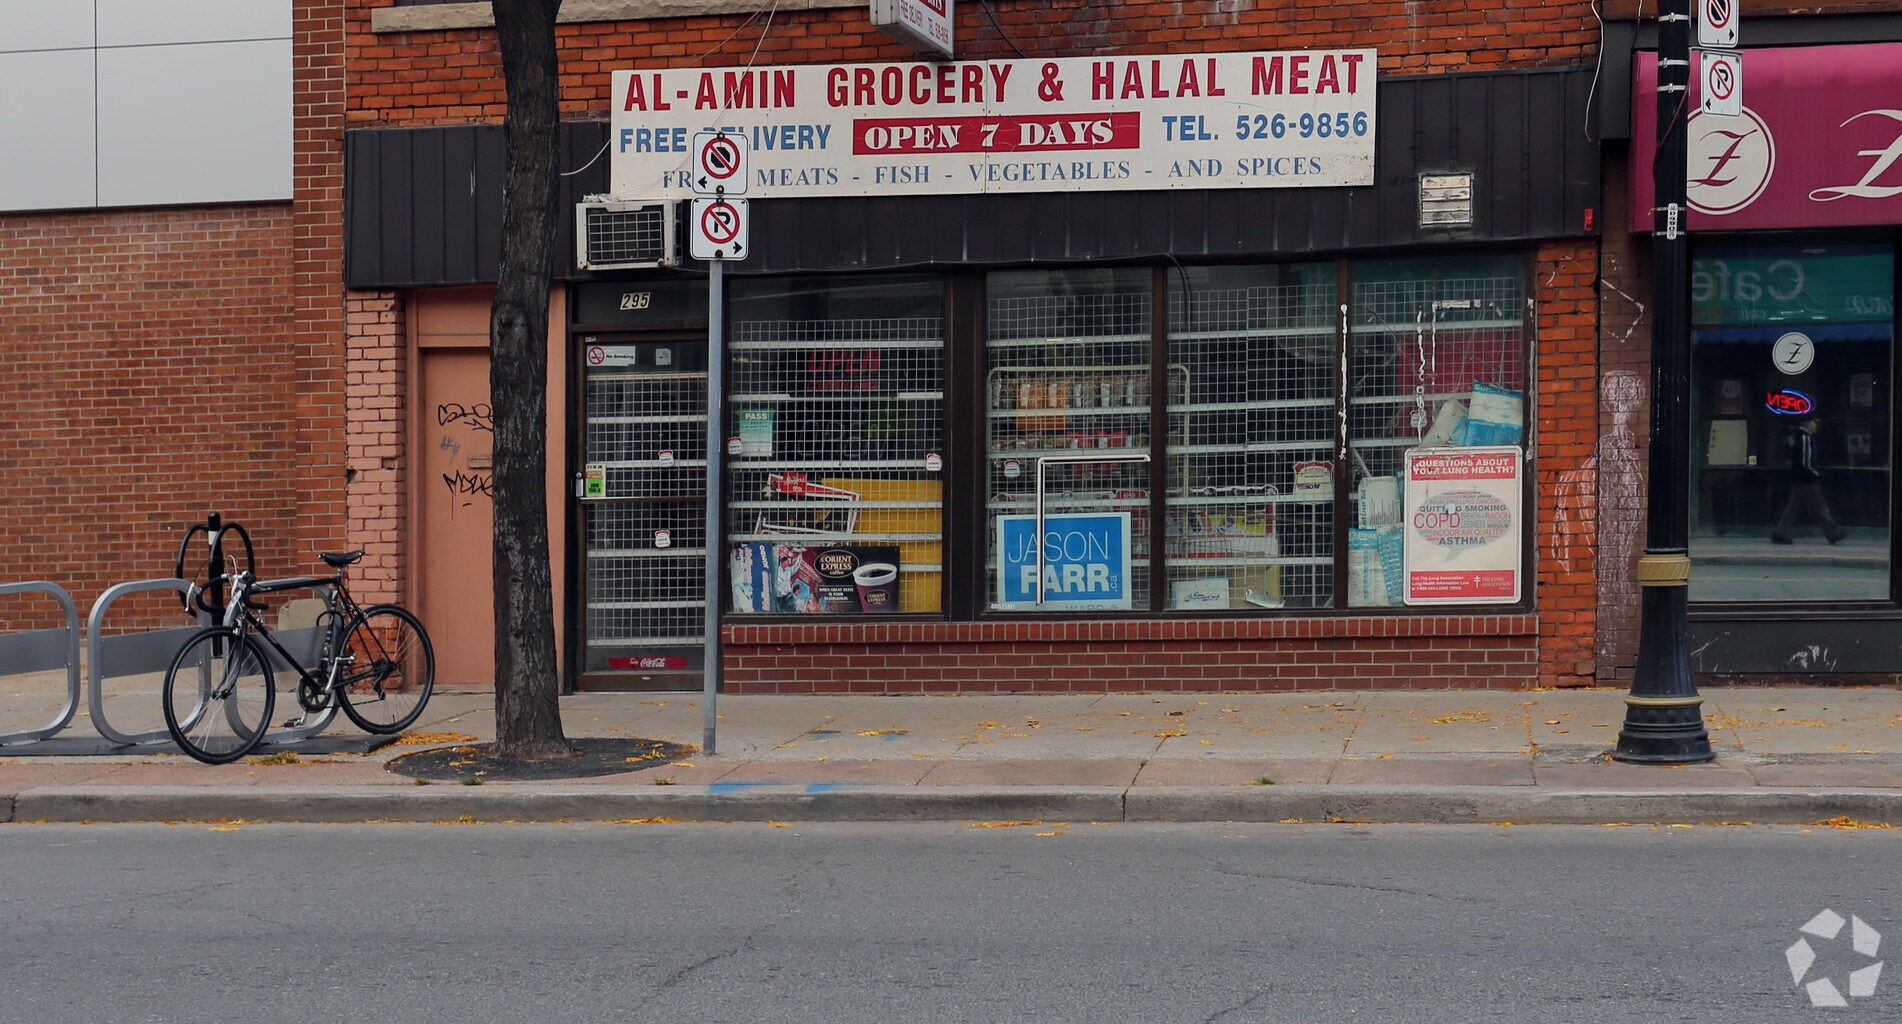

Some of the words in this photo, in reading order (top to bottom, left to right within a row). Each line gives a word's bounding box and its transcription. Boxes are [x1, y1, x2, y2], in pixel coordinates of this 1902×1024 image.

[624, 70, 795, 112] AL-AMIN
[827, 63, 1013, 107] GROCERY
[1037, 62, 1065, 102] &
[1092, 58, 1226, 101] HALAL
[1252, 54, 1364, 96] MEAT
[620, 128, 687, 153] FREE
[864, 125, 961, 149] OPEN
[981, 123, 998, 148] 7
[1018, 119, 1114, 146] DAYS
[1162, 115, 1219, 141] TEL.
[1236, 111, 1368, 139] 526-9856
[756, 167, 839, 186] MEATS
[874, 165, 930, 184] FISH
[968, 159, 1131, 183] VEGETABLES
[1168, 159, 1223, 178] AND
[1237, 157, 1322, 176] SPICES
[622, 293, 650, 309] 295
[745, 412, 768, 421] PASS
[1414, 467, 1440, 475] YOUR
[1472, 466, 1515, 474] HEALTH?
[1420, 459, 1474, 467] QUESTIONS
[1476, 458, 1509, 466] ABOUT
[1420, 505, 1462, 513] QUITTG
[1465, 504, 1506, 512] SMOKING
[1414, 512, 1461, 528] COPD
[1485, 512, 1511, 520] RADON
[1474, 528, 1505, 536] QUALITY
[1008, 531, 1108, 563] JASON
[1438, 537, 1487, 546] ASTHMA
[1021, 563, 1110, 594] FARR
